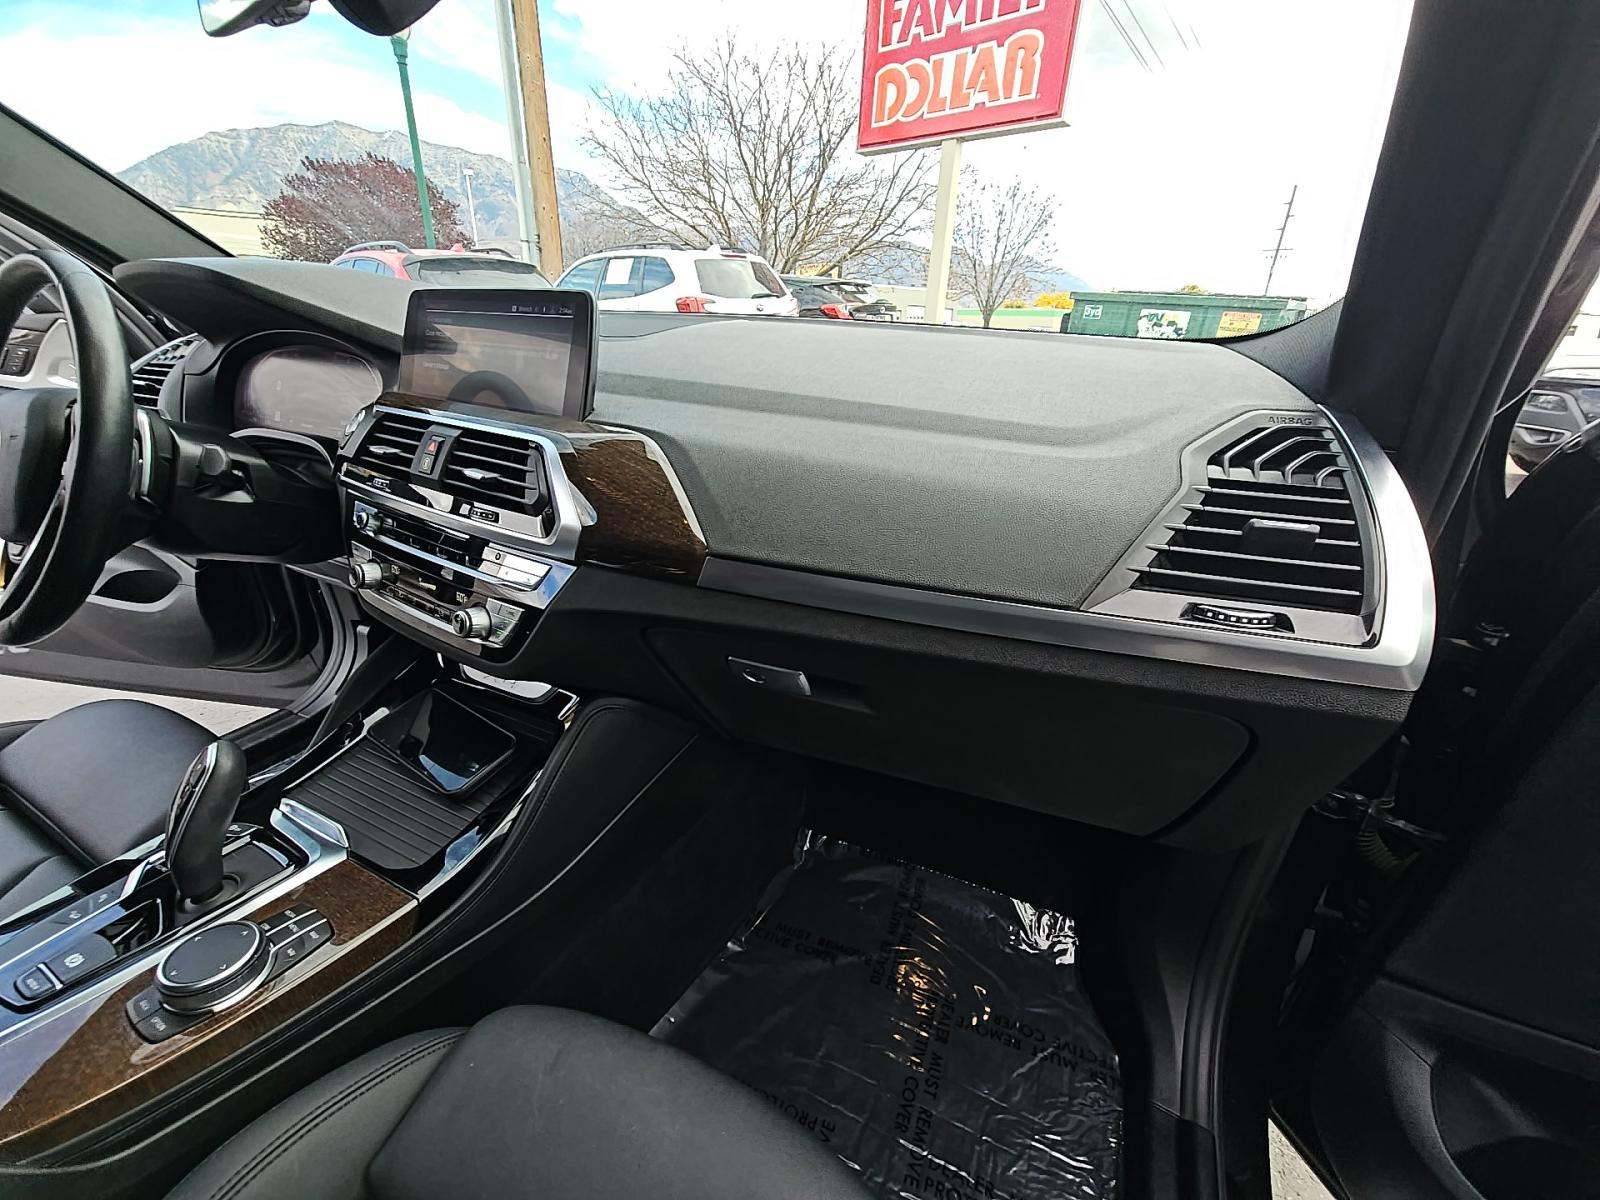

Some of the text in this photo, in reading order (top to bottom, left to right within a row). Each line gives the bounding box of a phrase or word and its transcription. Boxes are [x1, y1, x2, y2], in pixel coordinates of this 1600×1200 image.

[873, 31, 1042, 126] DOLLAR
[1268, 415, 1313, 426] AIRBAG
[923, 1051, 944, 1100] MUST
[894, 1076, 919, 1133] COVER
[903, 1106, 934, 1190] REMOVE
